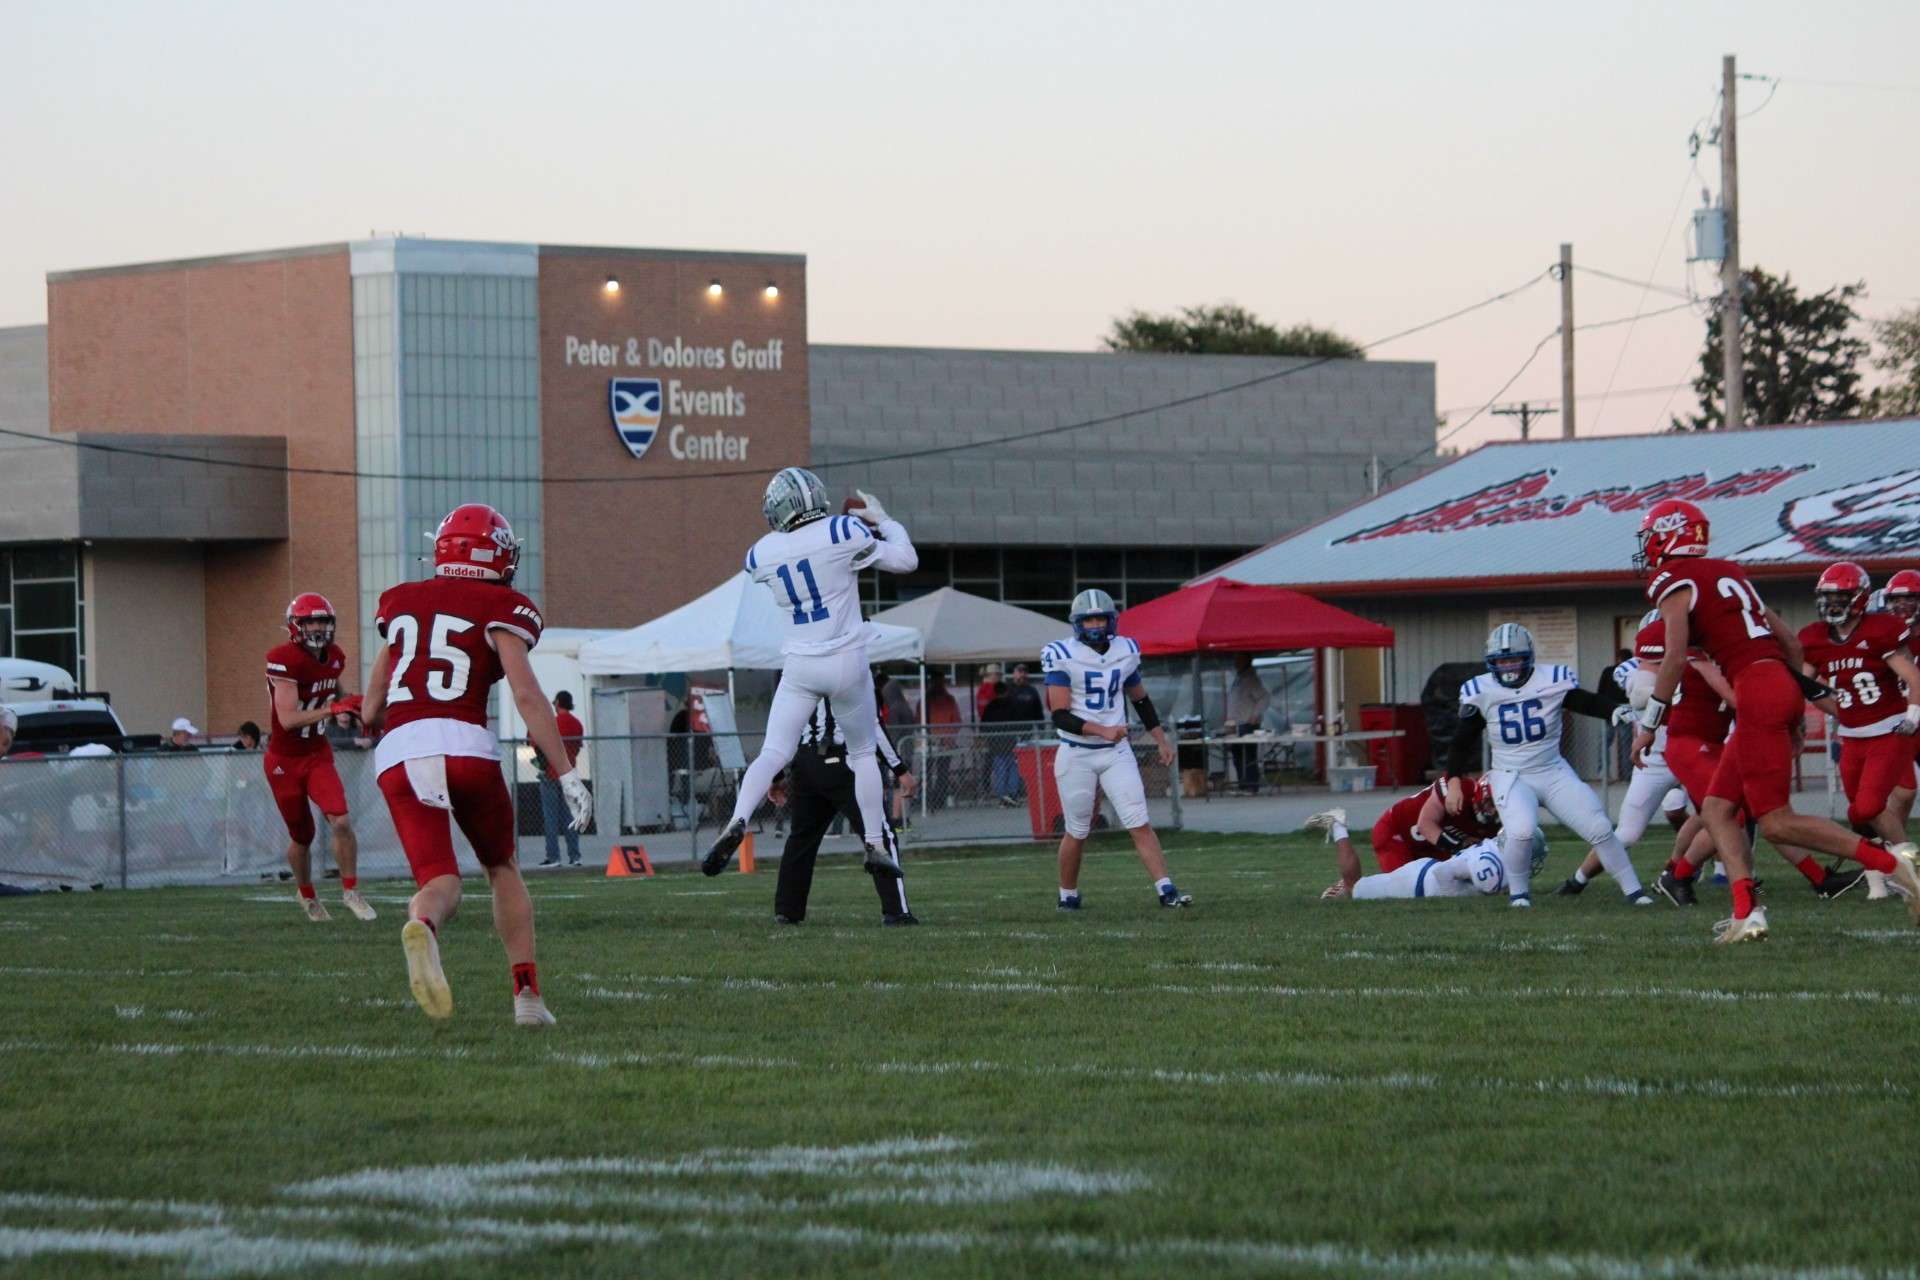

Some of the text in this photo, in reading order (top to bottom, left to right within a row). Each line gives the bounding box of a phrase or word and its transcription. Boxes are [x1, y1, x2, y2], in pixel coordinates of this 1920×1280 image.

[565, 335, 783, 371] Peter & Dolores Graff
[668, 379, 746, 417] Events
[668, 424, 750, 461] Center
[443, 566, 485, 578] Riddell
[776, 558, 830, 625] 11
[1716, 576, 1774, 640] 2
[386, 612, 476, 707] 25
[1828, 657, 1864, 673] BISON
[1084, 667, 1121, 712] 54
[1498, 698, 1547, 745] 66
[620, 845, 647, 873] G
[1476, 866, 1495, 882] 5
